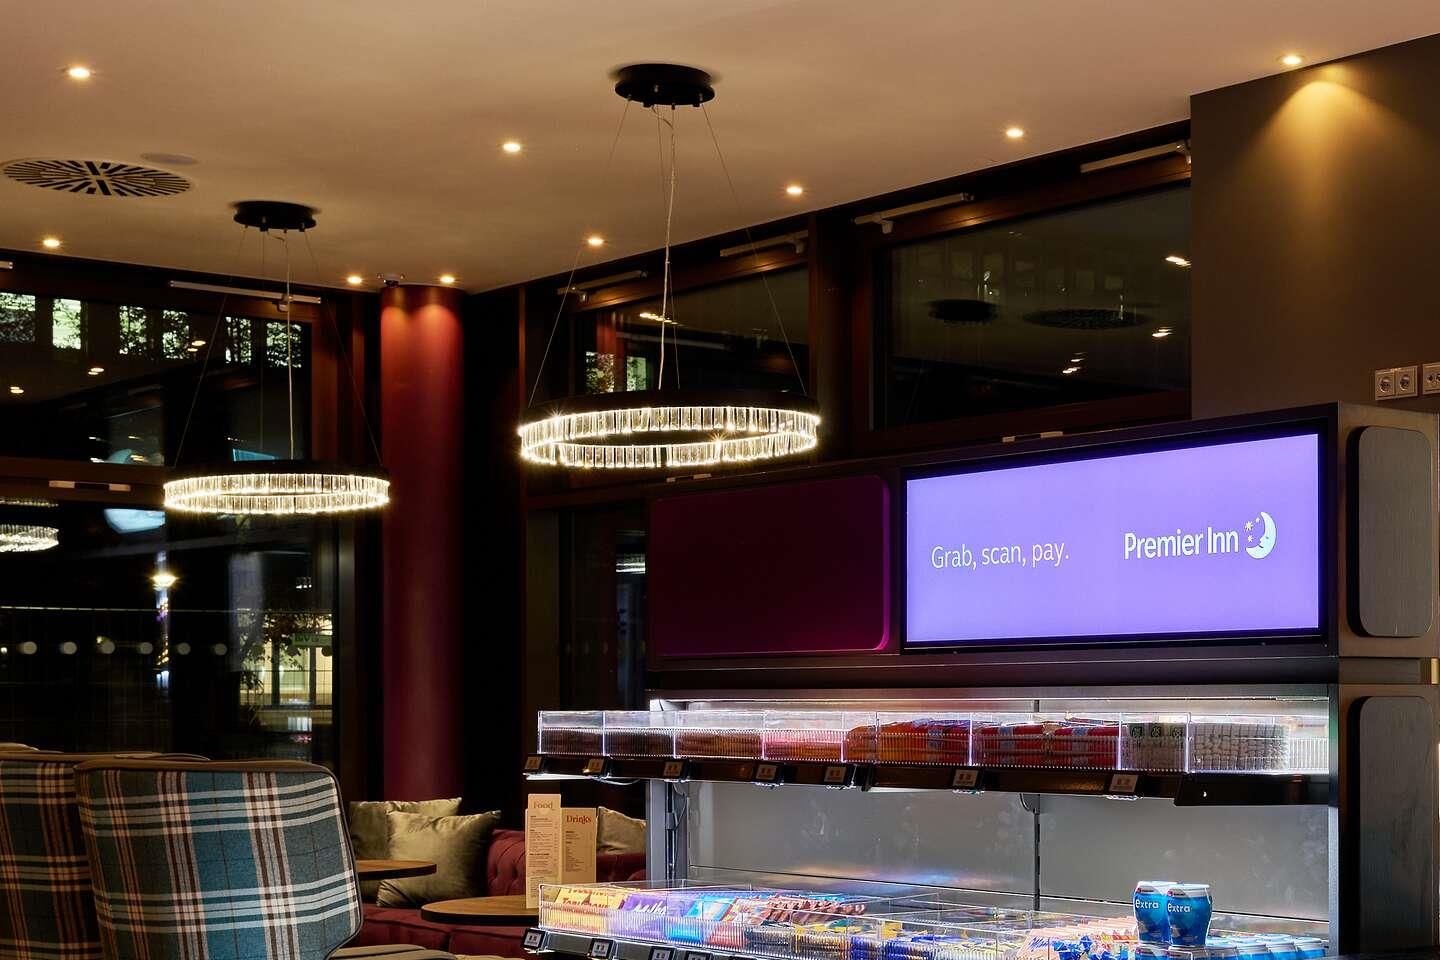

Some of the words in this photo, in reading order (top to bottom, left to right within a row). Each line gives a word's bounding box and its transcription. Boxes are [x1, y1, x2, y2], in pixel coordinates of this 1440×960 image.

[1124, 529, 1203, 560] Premier
[1208, 526, 1239, 554] Inn
[931, 544, 977, 570] Grab,
[981, 545, 1026, 567] scan,
[1032, 542, 1069, 568] pay.
[566, 815, 592, 824] Drinks
[1135, 899, 1159, 910] extra
[1167, 902, 1191, 913] extra
